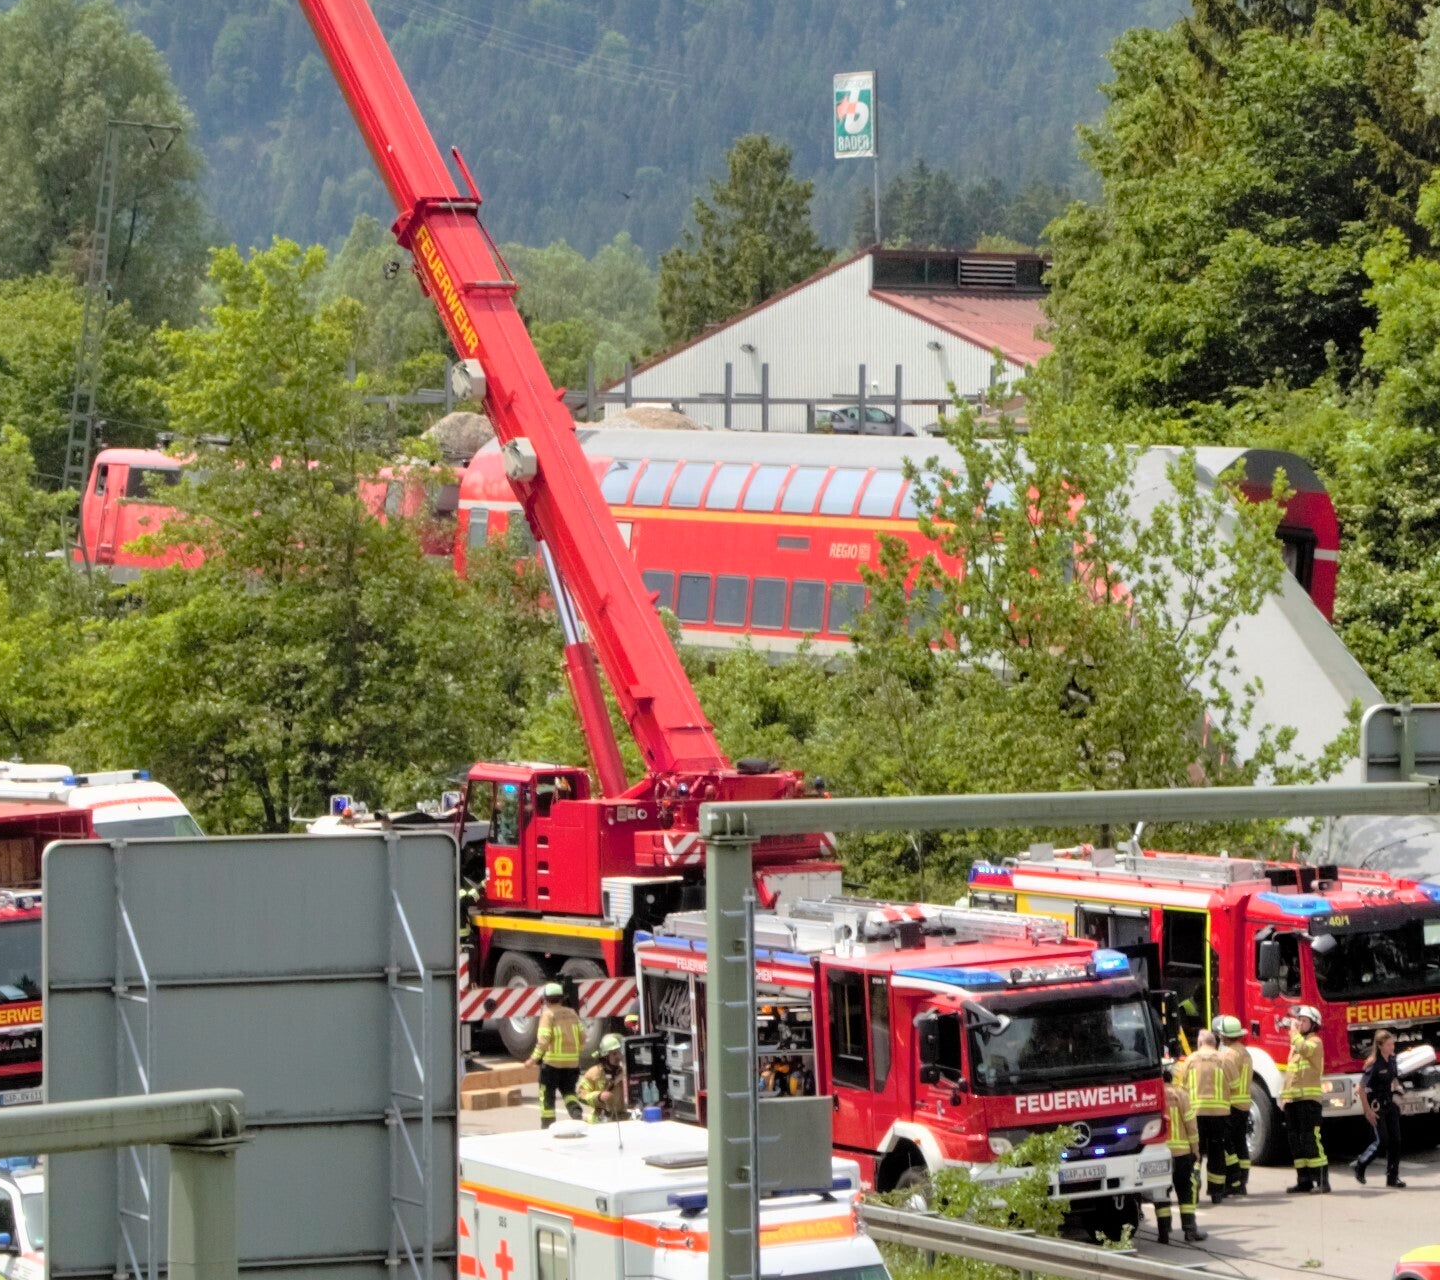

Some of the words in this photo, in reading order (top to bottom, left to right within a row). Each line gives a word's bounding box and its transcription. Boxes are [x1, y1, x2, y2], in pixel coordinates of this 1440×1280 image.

[838, 134, 870, 151] BADER
[415, 224, 480, 355] FEUERWEHR
[829, 542, 858, 559] REGIO
[495, 879, 513, 899] 112
[1329, 915, 1350, 926] 40/1
[1015, 1084, 1137, 1114] FEUERWEHR
